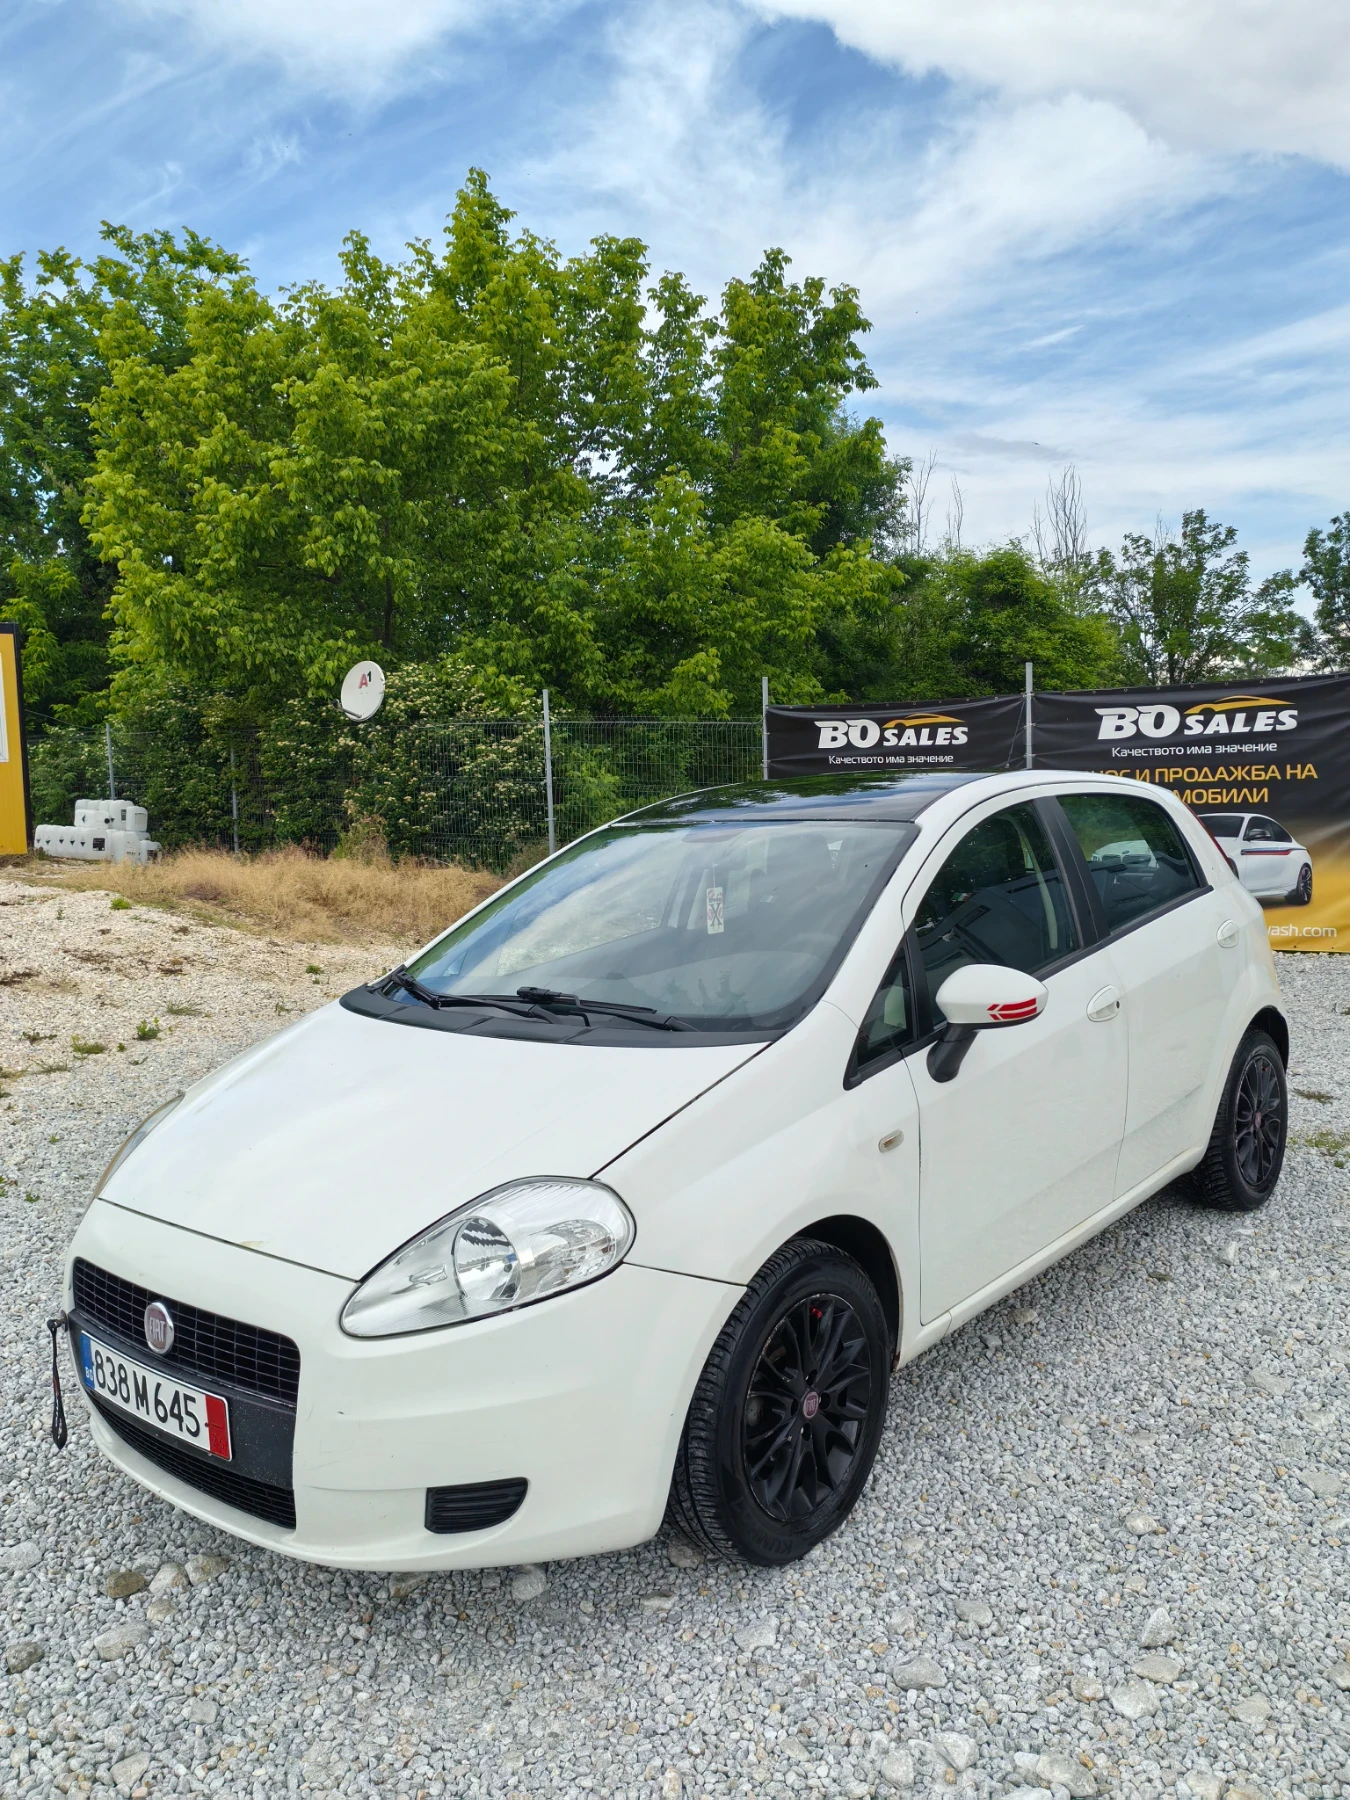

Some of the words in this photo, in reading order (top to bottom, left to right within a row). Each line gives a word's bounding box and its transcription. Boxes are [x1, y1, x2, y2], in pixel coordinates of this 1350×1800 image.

[358, 671, 372, 689] A1
[1184, 710, 1298, 735] SALES
[883, 727, 968, 746] SALES
[1112, 745, 1184, 757] Качеството
[1186, 746, 1212, 754] има
[1215, 743, 1277, 753] значение
[829, 755, 884, 764] Качеството
[907, 755, 953, 763] значение
[1155, 765, 1281, 783] ПРОДАЖБА
[1286, 764, 1318, 780] НА
[150, 1316, 166, 1342] FIAT
[85, 1366, 93, 1380] BG
